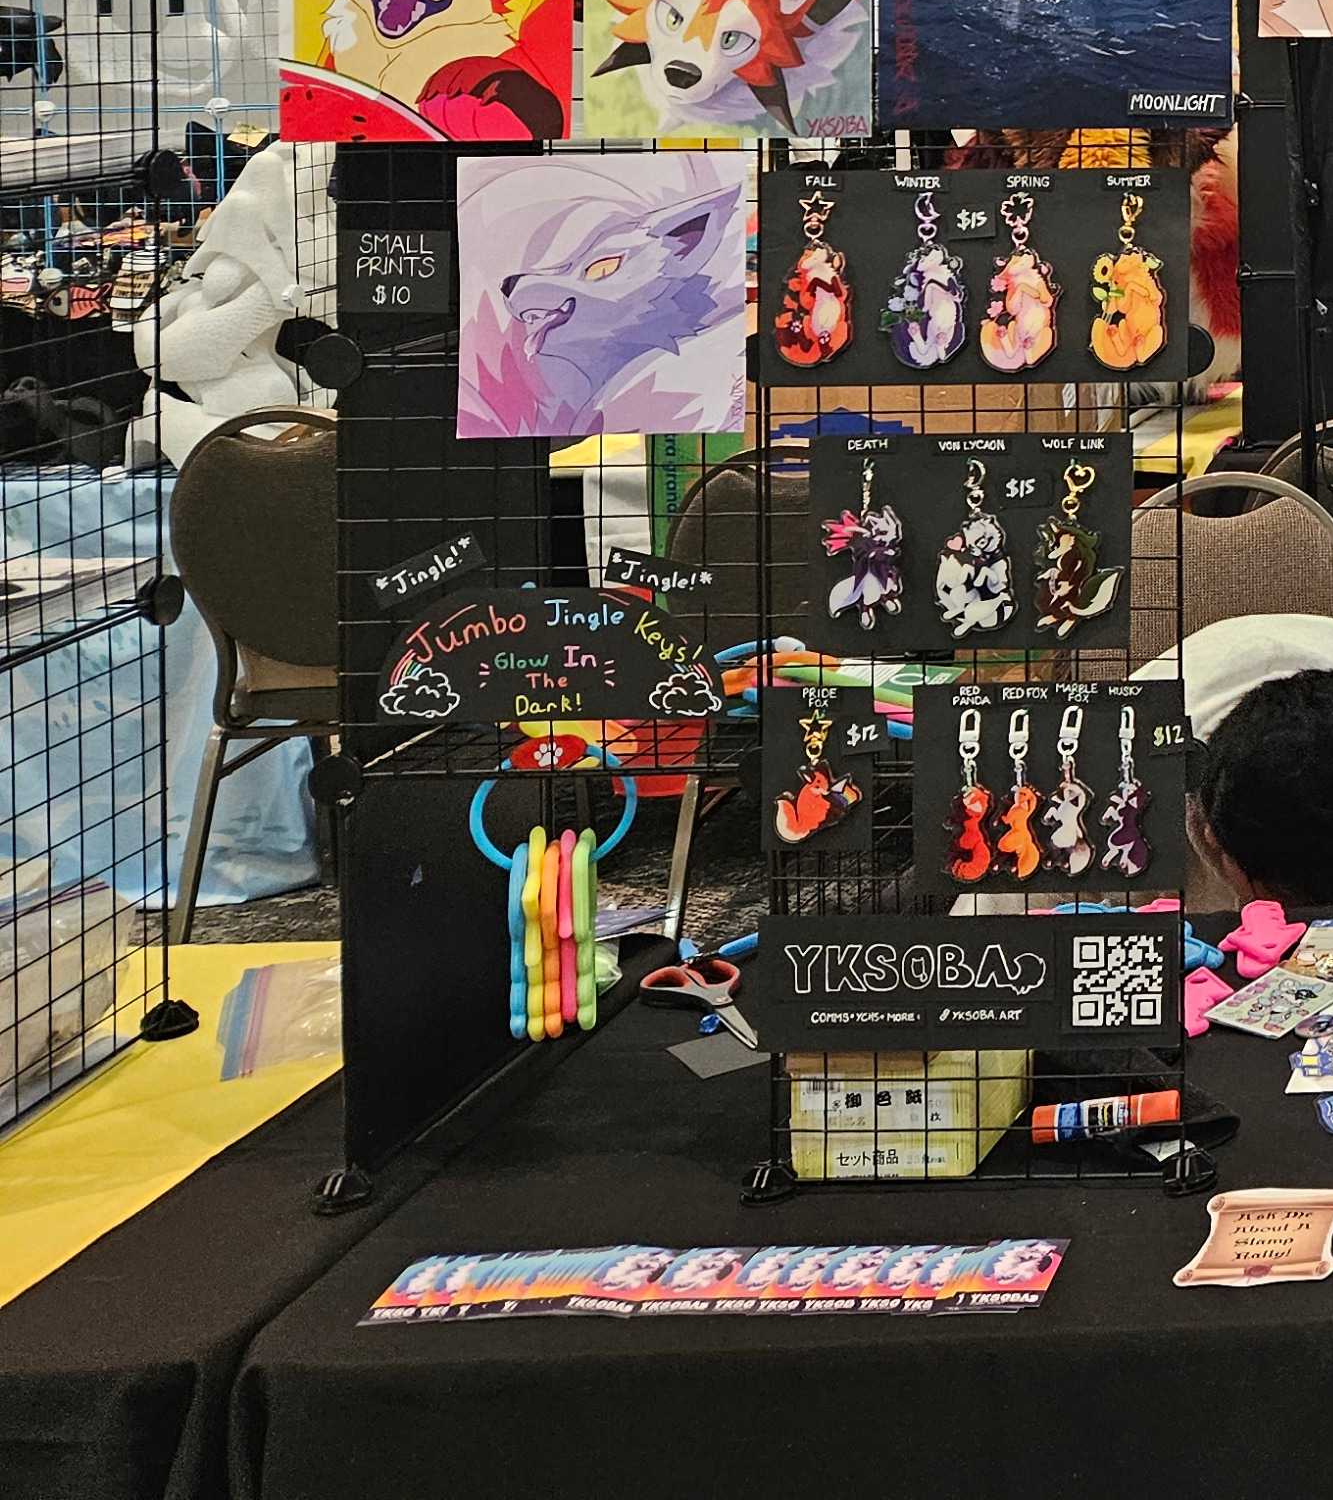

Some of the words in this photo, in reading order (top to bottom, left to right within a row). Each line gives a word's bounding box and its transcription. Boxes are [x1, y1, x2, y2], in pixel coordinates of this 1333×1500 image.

[1130, 93, 1226, 113] MOONLIGHT
[804, 175, 837, 187] FALL
[894, 175, 941, 189] WINTER
[1005, 175, 1051, 189] SPRING
[1106, 175, 1152, 188] SUMMER
[955, 208, 988, 230] $15
[359, 232, 434, 254] SMALL
[356, 256, 436, 278] PRINTS
[372, 284, 411, 305] $10
[847, 439, 889, 450] DEATH
[938, 440, 961, 451] VON
[963, 440, 1006, 451] LYCAON
[1042, 438, 1075, 450] WOLF
[1080, 438, 1105, 450] LINK
[1005, 477, 1037, 498] $15
[406, 603, 527, 664] Jumbo
[543, 599, 626, 632] Jingle
[633, 610, 704, 662] Keys!
[494, 651, 550, 670] Glow
[563, 645, 598, 668] In
[525, 672, 569, 689] The
[802, 687, 838, 699] PRIDE
[959, 686, 981, 697] RED
[1002, 687, 1025, 700] RED
[1025, 687, 1050, 700] FOX
[1055, 683, 1099, 695] MARBLE
[1108, 685, 1144, 697] HUSKY
[515, 693, 583, 716] Dark!
[808, 698, 829, 708] FOX
[952, 695, 992, 706] PANDA
[1067, 693, 1090, 704] FOX
[846, 723, 879, 747] $12
[1153, 724, 1186, 747] $12
[784, 944, 1046, 995] YKSOBA
[951, 1008, 1023, 1021] YKSOBA.ART
[1233, 1237, 1294, 1248] Stamp
